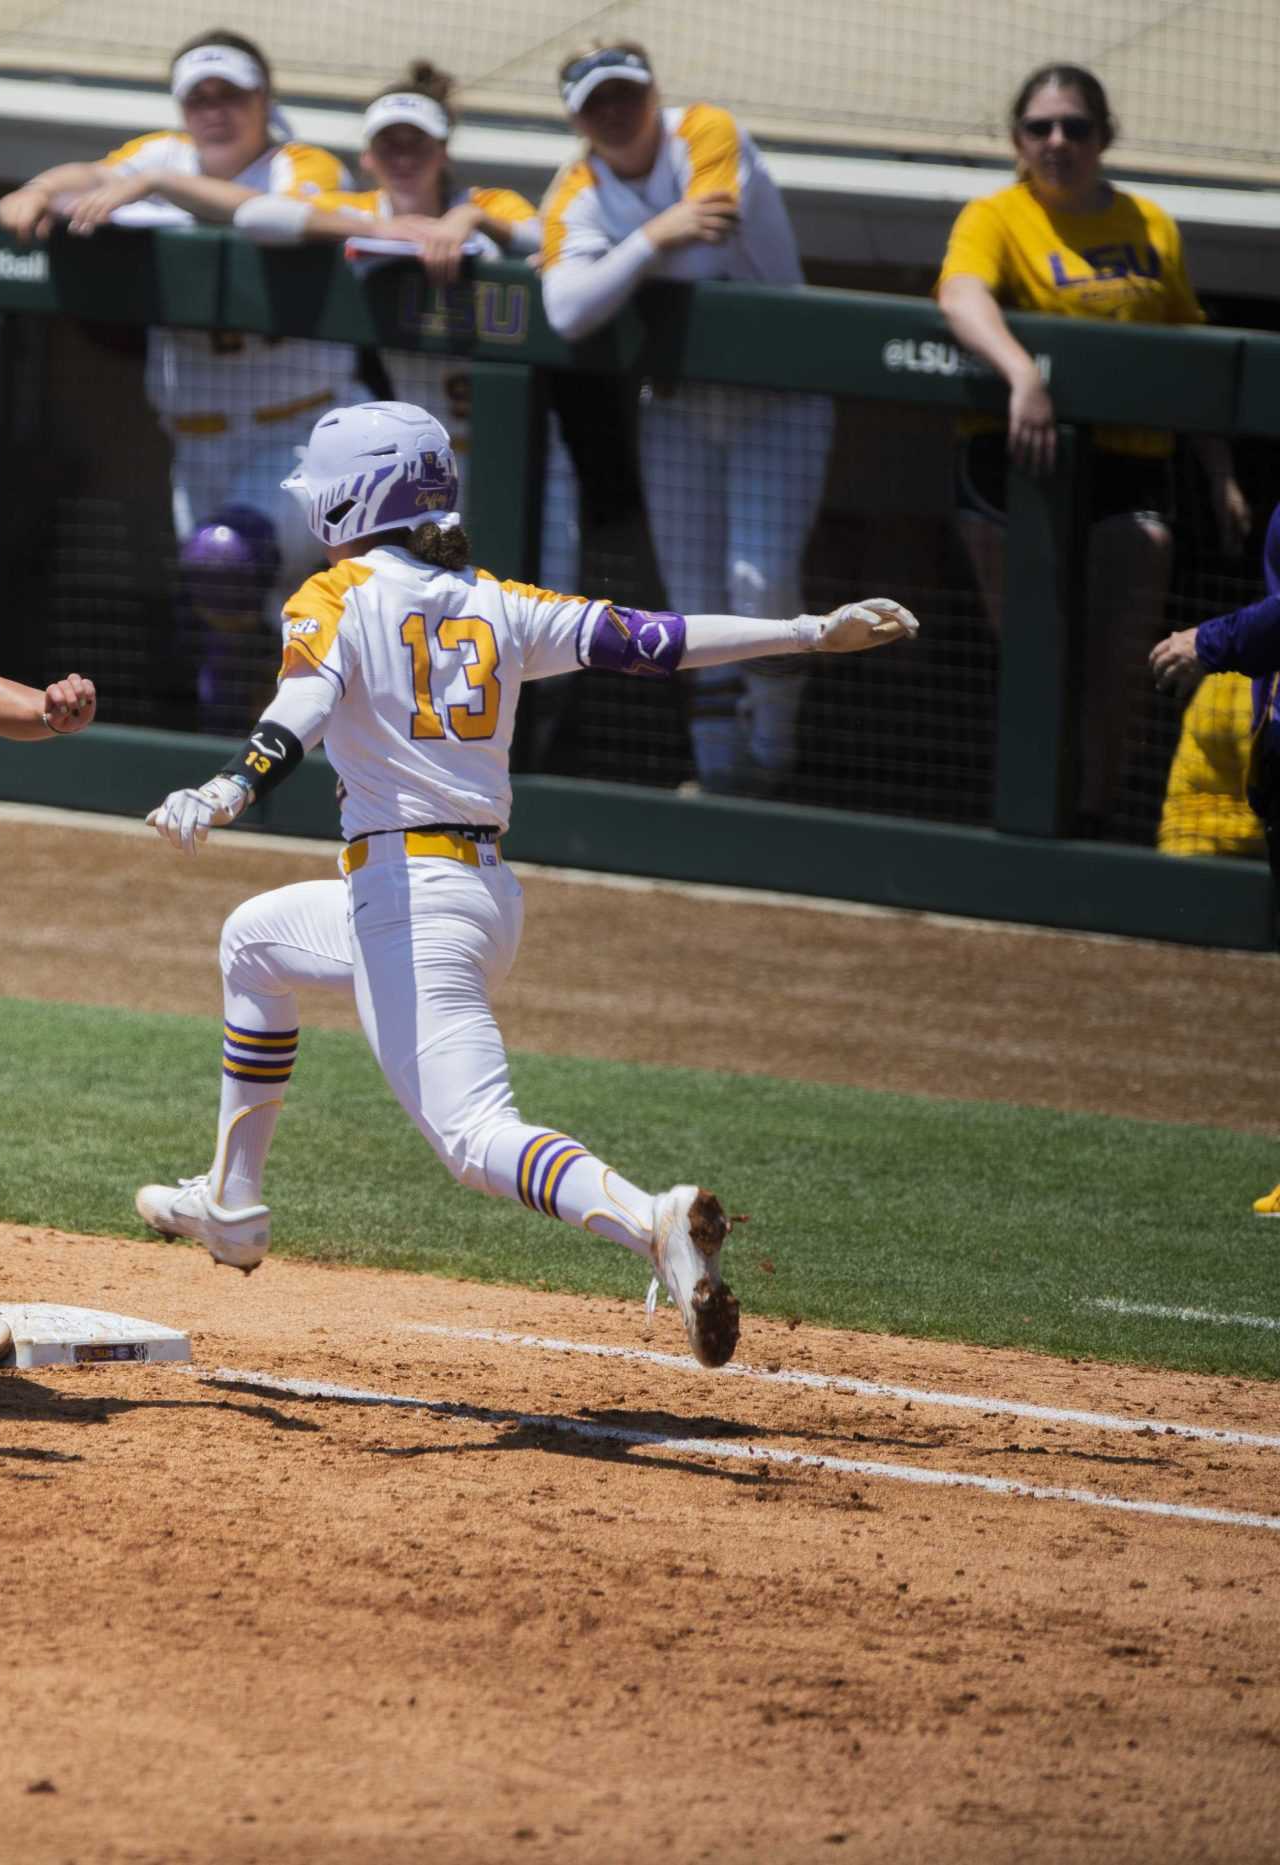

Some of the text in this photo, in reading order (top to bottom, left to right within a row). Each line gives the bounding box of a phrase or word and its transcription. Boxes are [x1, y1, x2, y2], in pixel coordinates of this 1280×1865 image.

[1048, 245, 1162, 287] LSU
[399, 612, 502, 741] 13
[245, 751, 272, 774] 13
